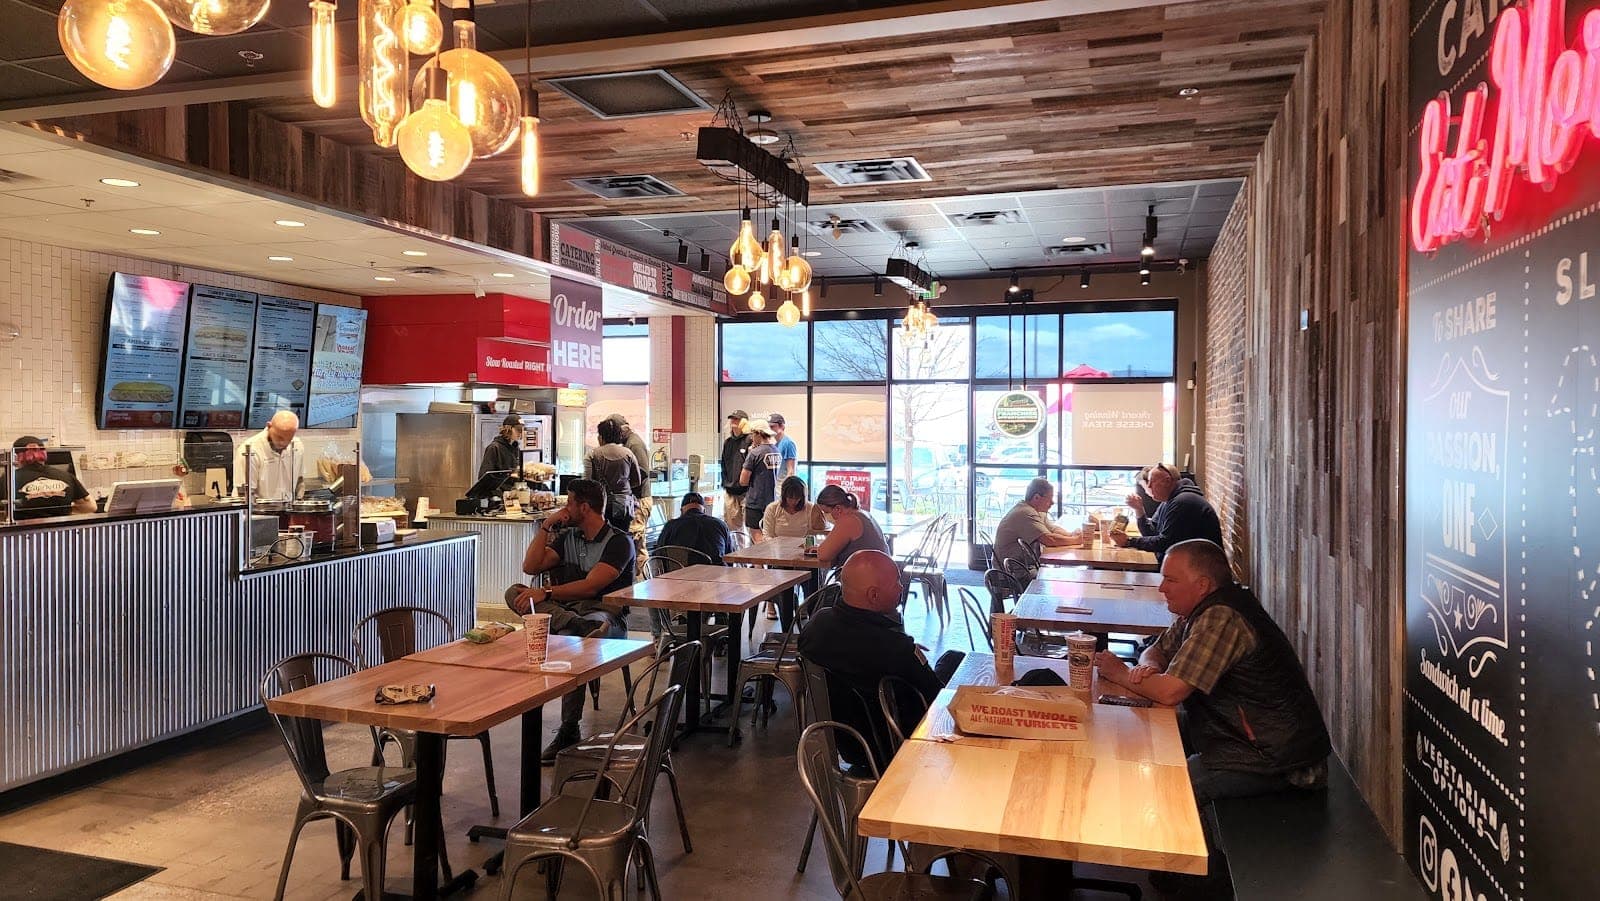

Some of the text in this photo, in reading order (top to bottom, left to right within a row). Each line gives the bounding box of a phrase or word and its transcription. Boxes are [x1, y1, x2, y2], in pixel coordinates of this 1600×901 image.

[1411, 82, 1490, 254] Eat
[560, 242, 595, 265] CATERING
[633, 272, 657, 294] ORDER
[553, 293, 602, 331] Order
[1445, 291, 1497, 341] SHARE
[485, 356, 500, 367] Slow
[501, 357, 523, 370] Roasted
[525, 361, 545, 372] RIGHT
[553, 339, 602, 370] HERE
[1442, 479, 1477, 557] ONE
[1420, 648, 1459, 704] Sandwich
[1460, 687, 1470, 713] at
[1472, 699, 1480, 721] a
[971, 704, 1079, 723] WE ROAST WHOLE
[1015, 718, 1079, 730] TURKEYS
[1423, 735, 1498, 831] VEGETARIAN
[1432, 767, 1484, 838] OPTIONS
